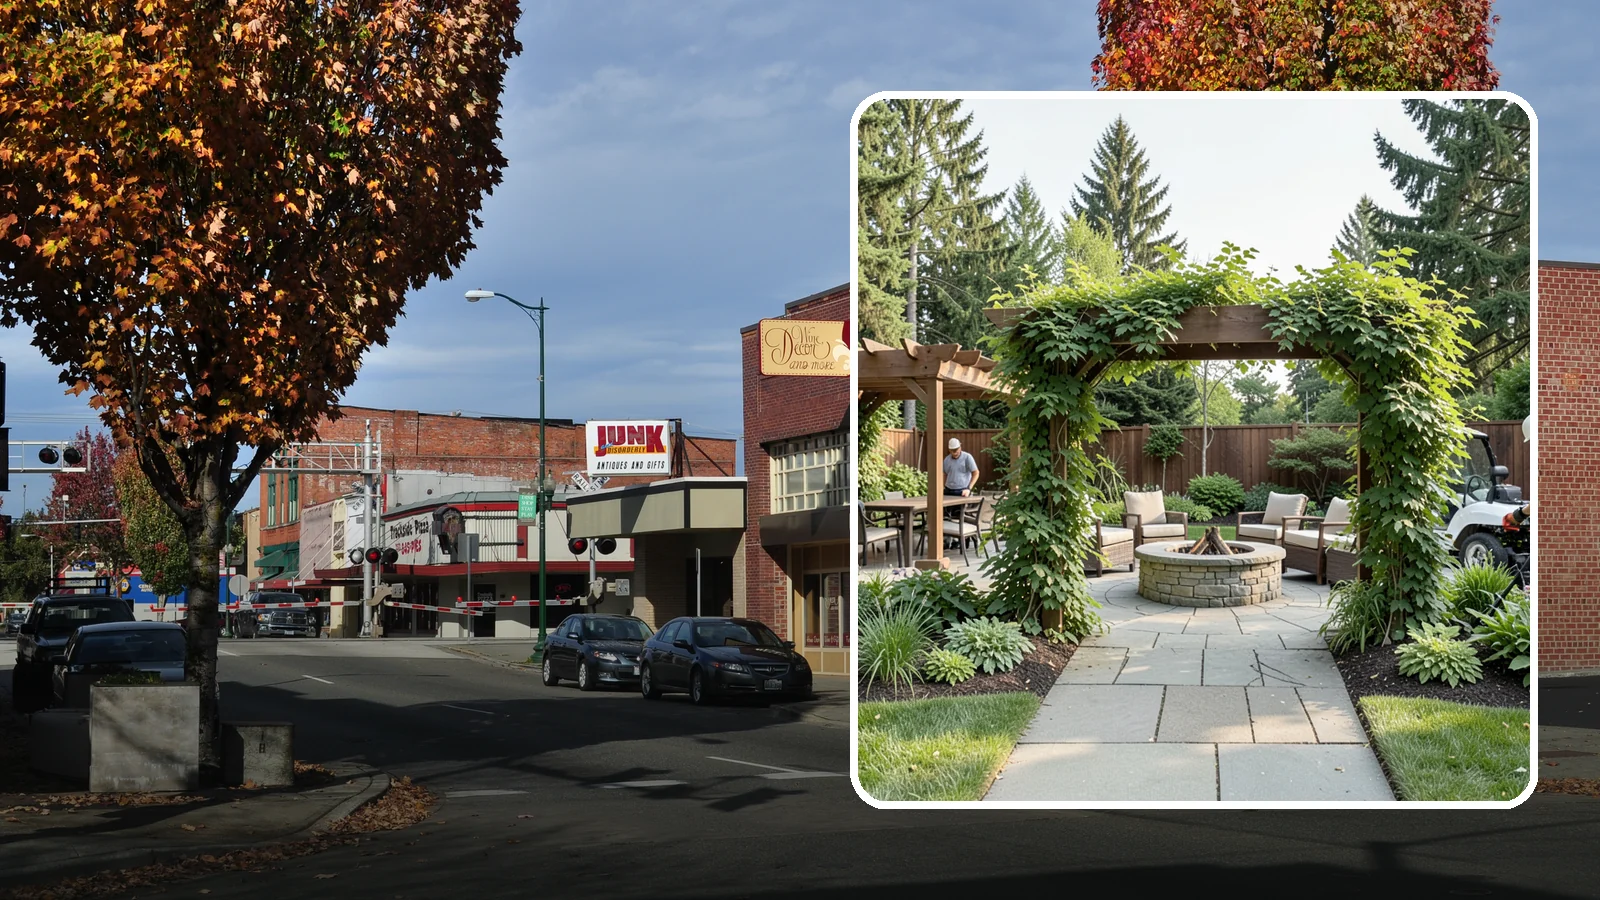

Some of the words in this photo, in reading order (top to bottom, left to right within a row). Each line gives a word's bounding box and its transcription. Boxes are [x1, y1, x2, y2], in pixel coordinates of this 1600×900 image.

[596, 425, 664, 457] JUNK
[607, 446, 646, 454] DISORDERLY
[596, 461, 628, 470] ANTIQUES
[631, 461, 644, 470] AND
[647, 460, 665, 470] GIFTS
[414, 519, 429, 535] Pizza
